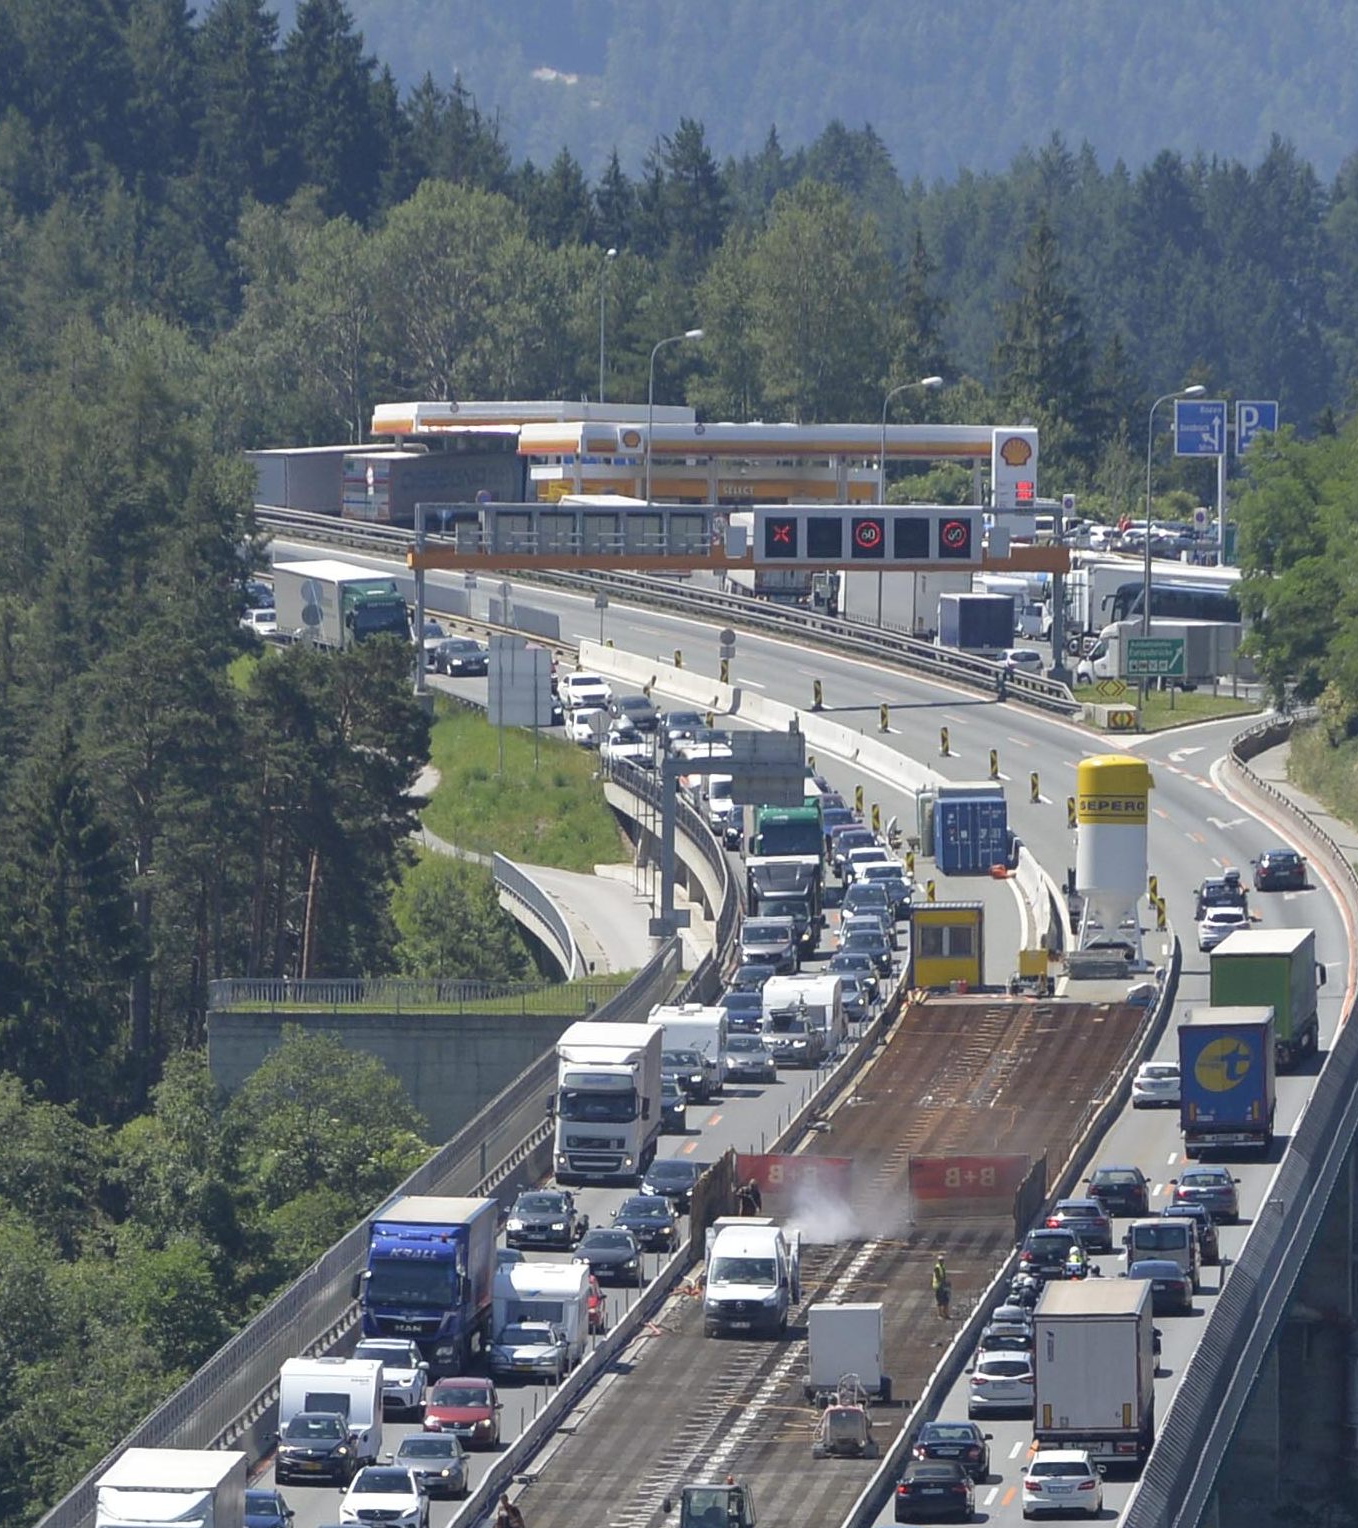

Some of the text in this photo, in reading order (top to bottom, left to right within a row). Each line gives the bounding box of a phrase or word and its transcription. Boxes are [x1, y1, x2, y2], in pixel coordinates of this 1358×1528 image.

[723, 486, 754, 495] SELECT
[861, 530, 876, 540] 60
[389, 1247, 438, 1259] KRALL
